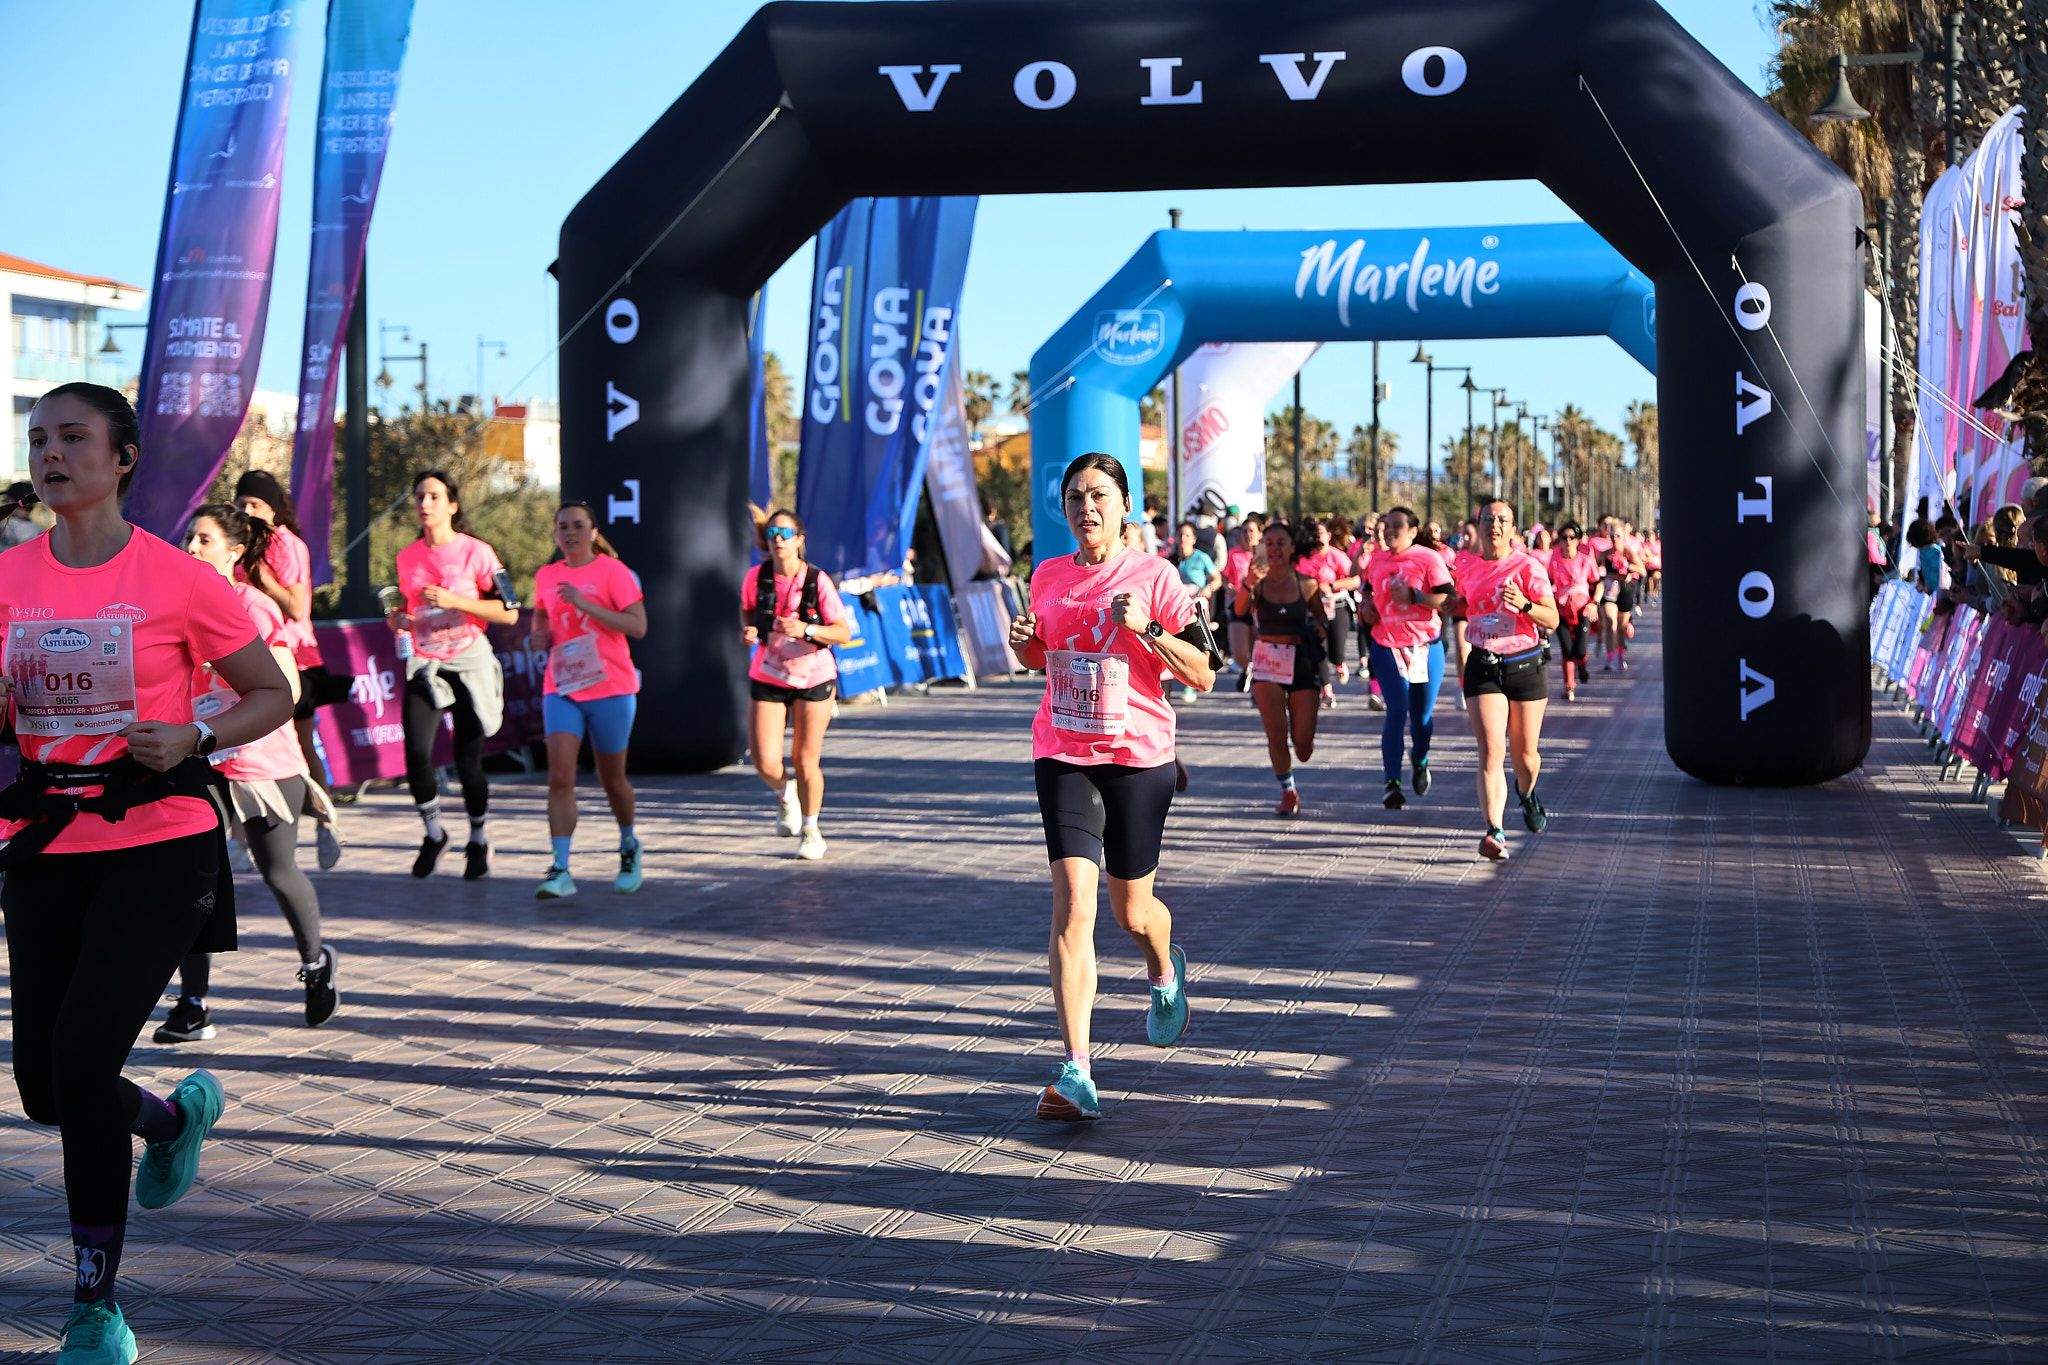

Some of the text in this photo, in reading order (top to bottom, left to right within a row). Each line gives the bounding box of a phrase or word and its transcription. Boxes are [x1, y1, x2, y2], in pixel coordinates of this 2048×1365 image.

[878, 45, 1467, 111] VOLVO
[1295, 237, 1500, 328] Marlene
[865, 286, 910, 436] GOYA
[1734, 281, 1776, 721] VOLVO
[42, 635, 88, 648] ASTURIANA
[44, 672, 93, 692] 016
[55, 696, 79, 705] 9055
[1072, 687, 1100, 702] 016
[47, 707, 56, 715] DE
[90, 703, 119, 714] VALENCIA
[84, 718, 122, 729] Santander
